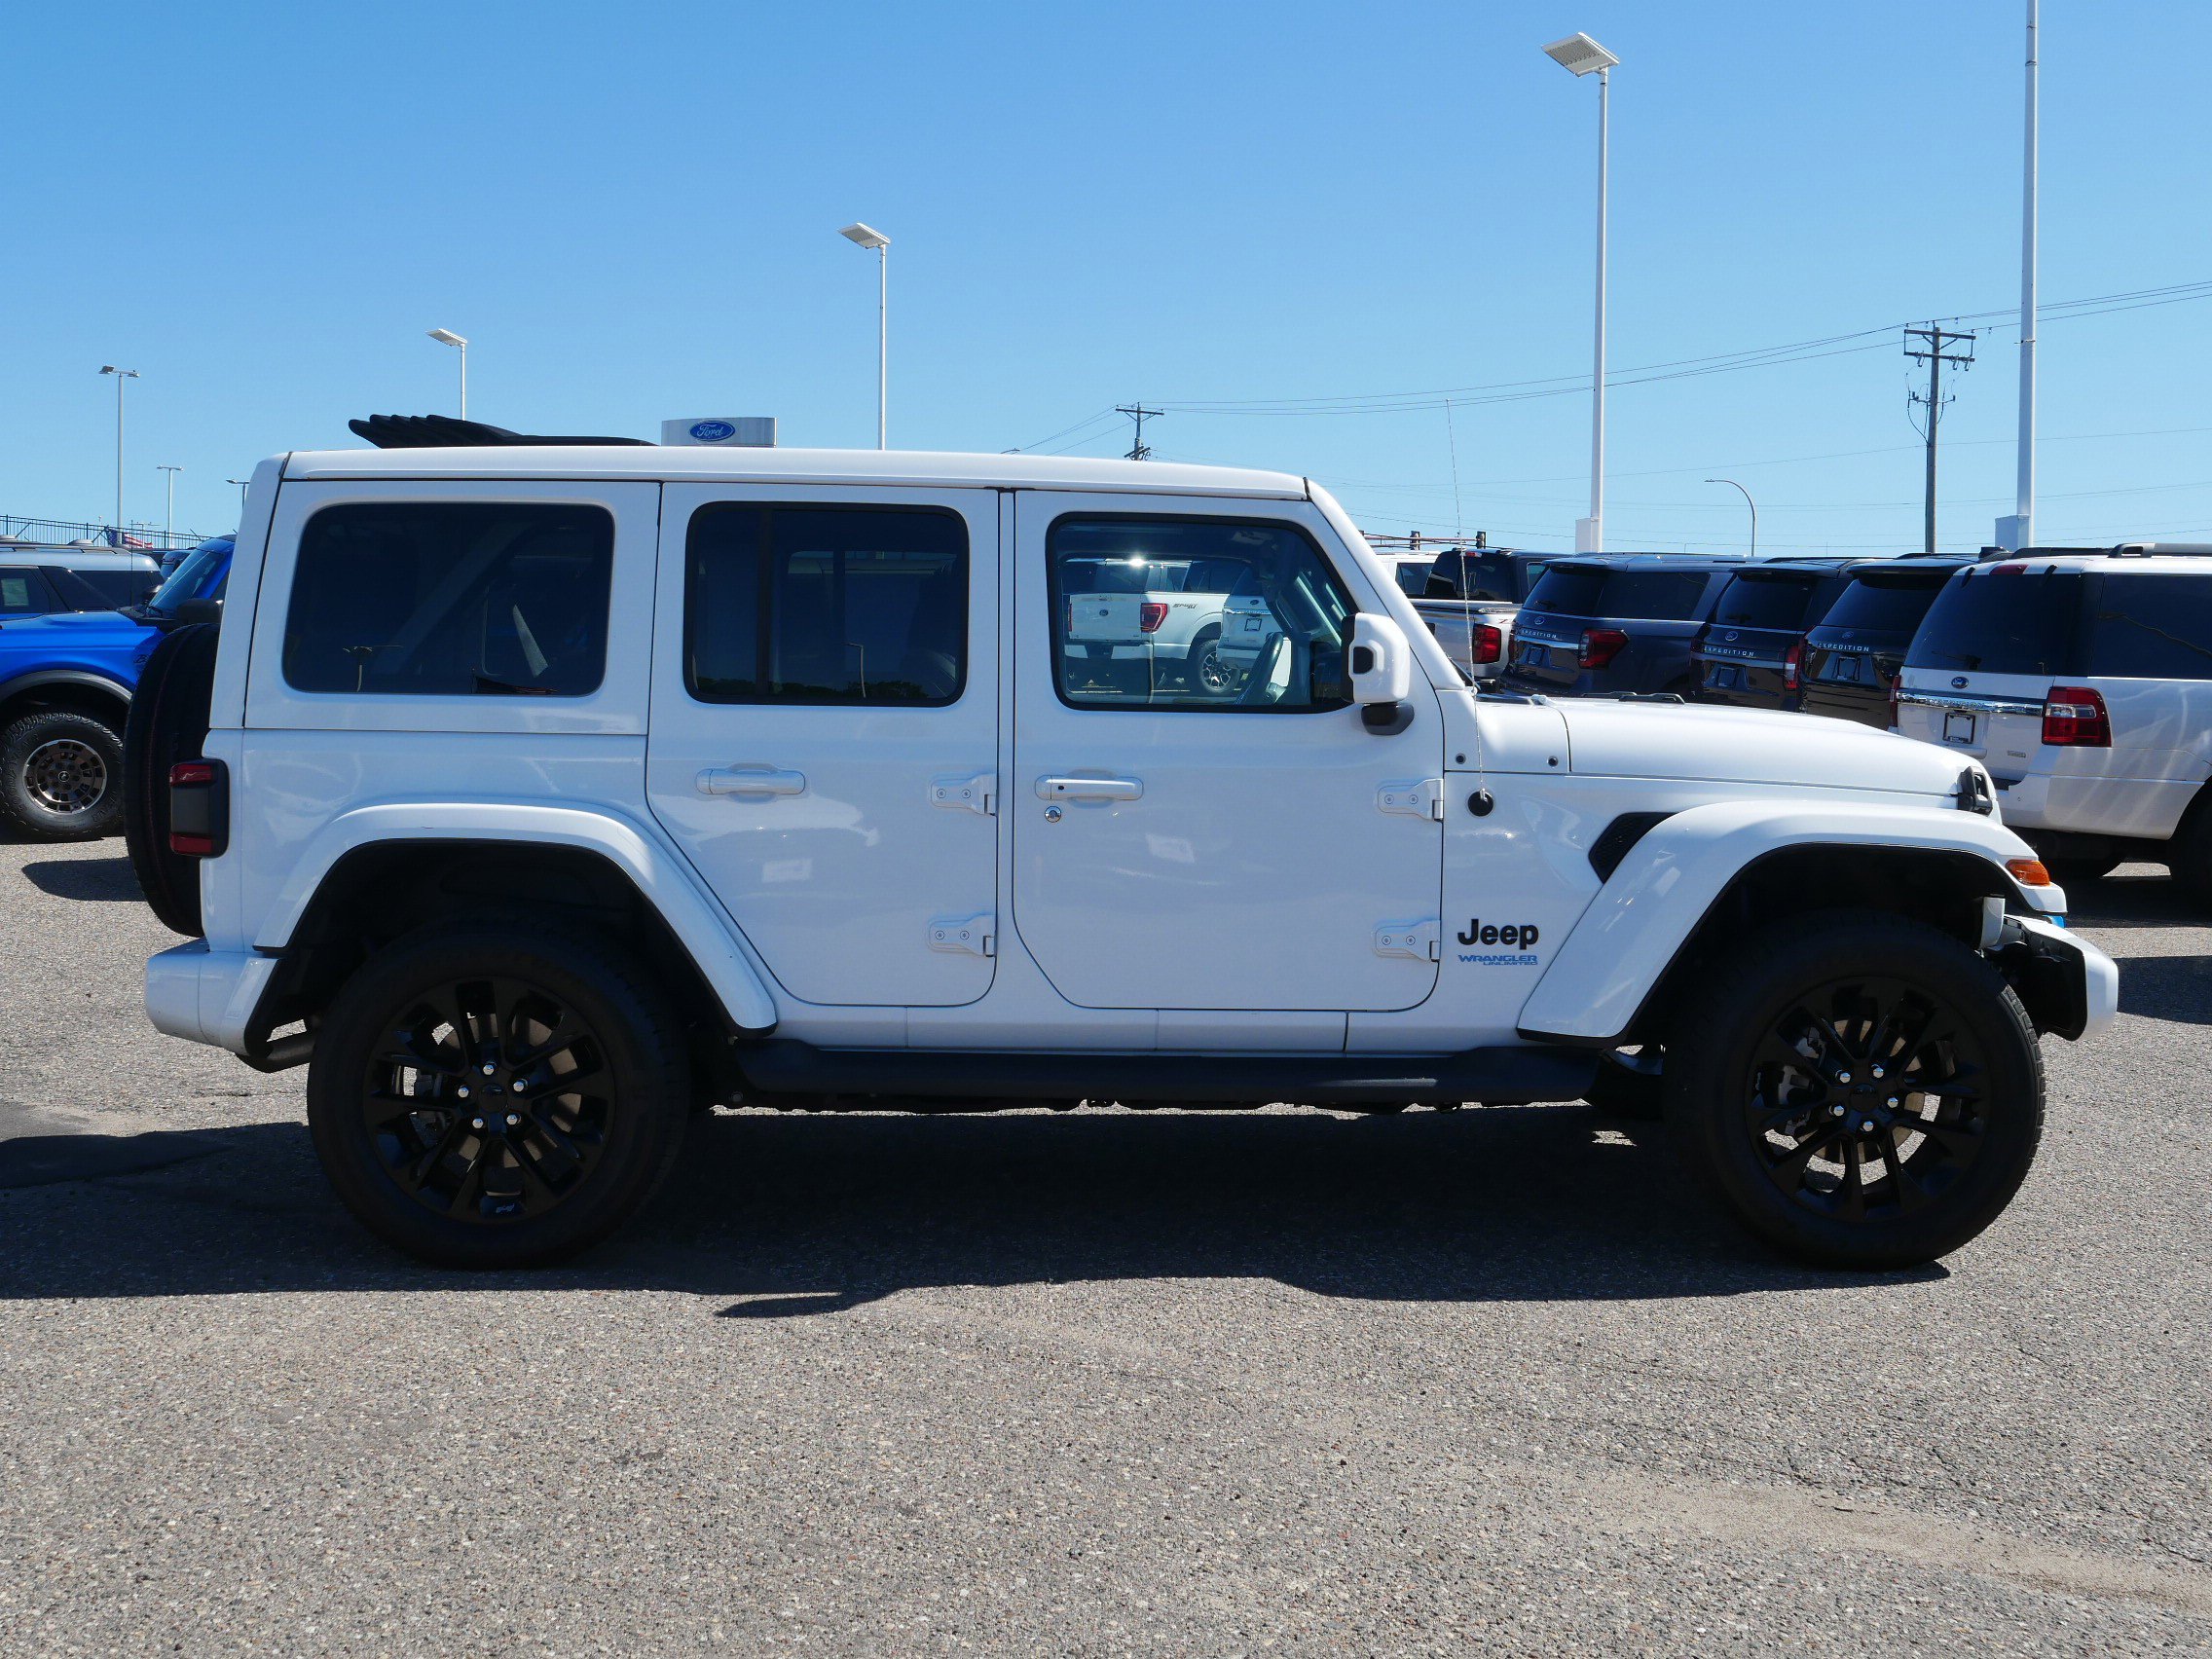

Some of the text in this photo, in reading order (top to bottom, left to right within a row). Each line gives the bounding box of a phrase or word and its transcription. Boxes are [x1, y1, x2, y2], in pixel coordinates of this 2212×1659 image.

[697, 424, 723, 436] Ford
[1704, 645, 1754, 656] EXPEDITION
[1818, 643, 1869, 652] EXPEDITION
[1456, 918, 1539, 950] Jeep
